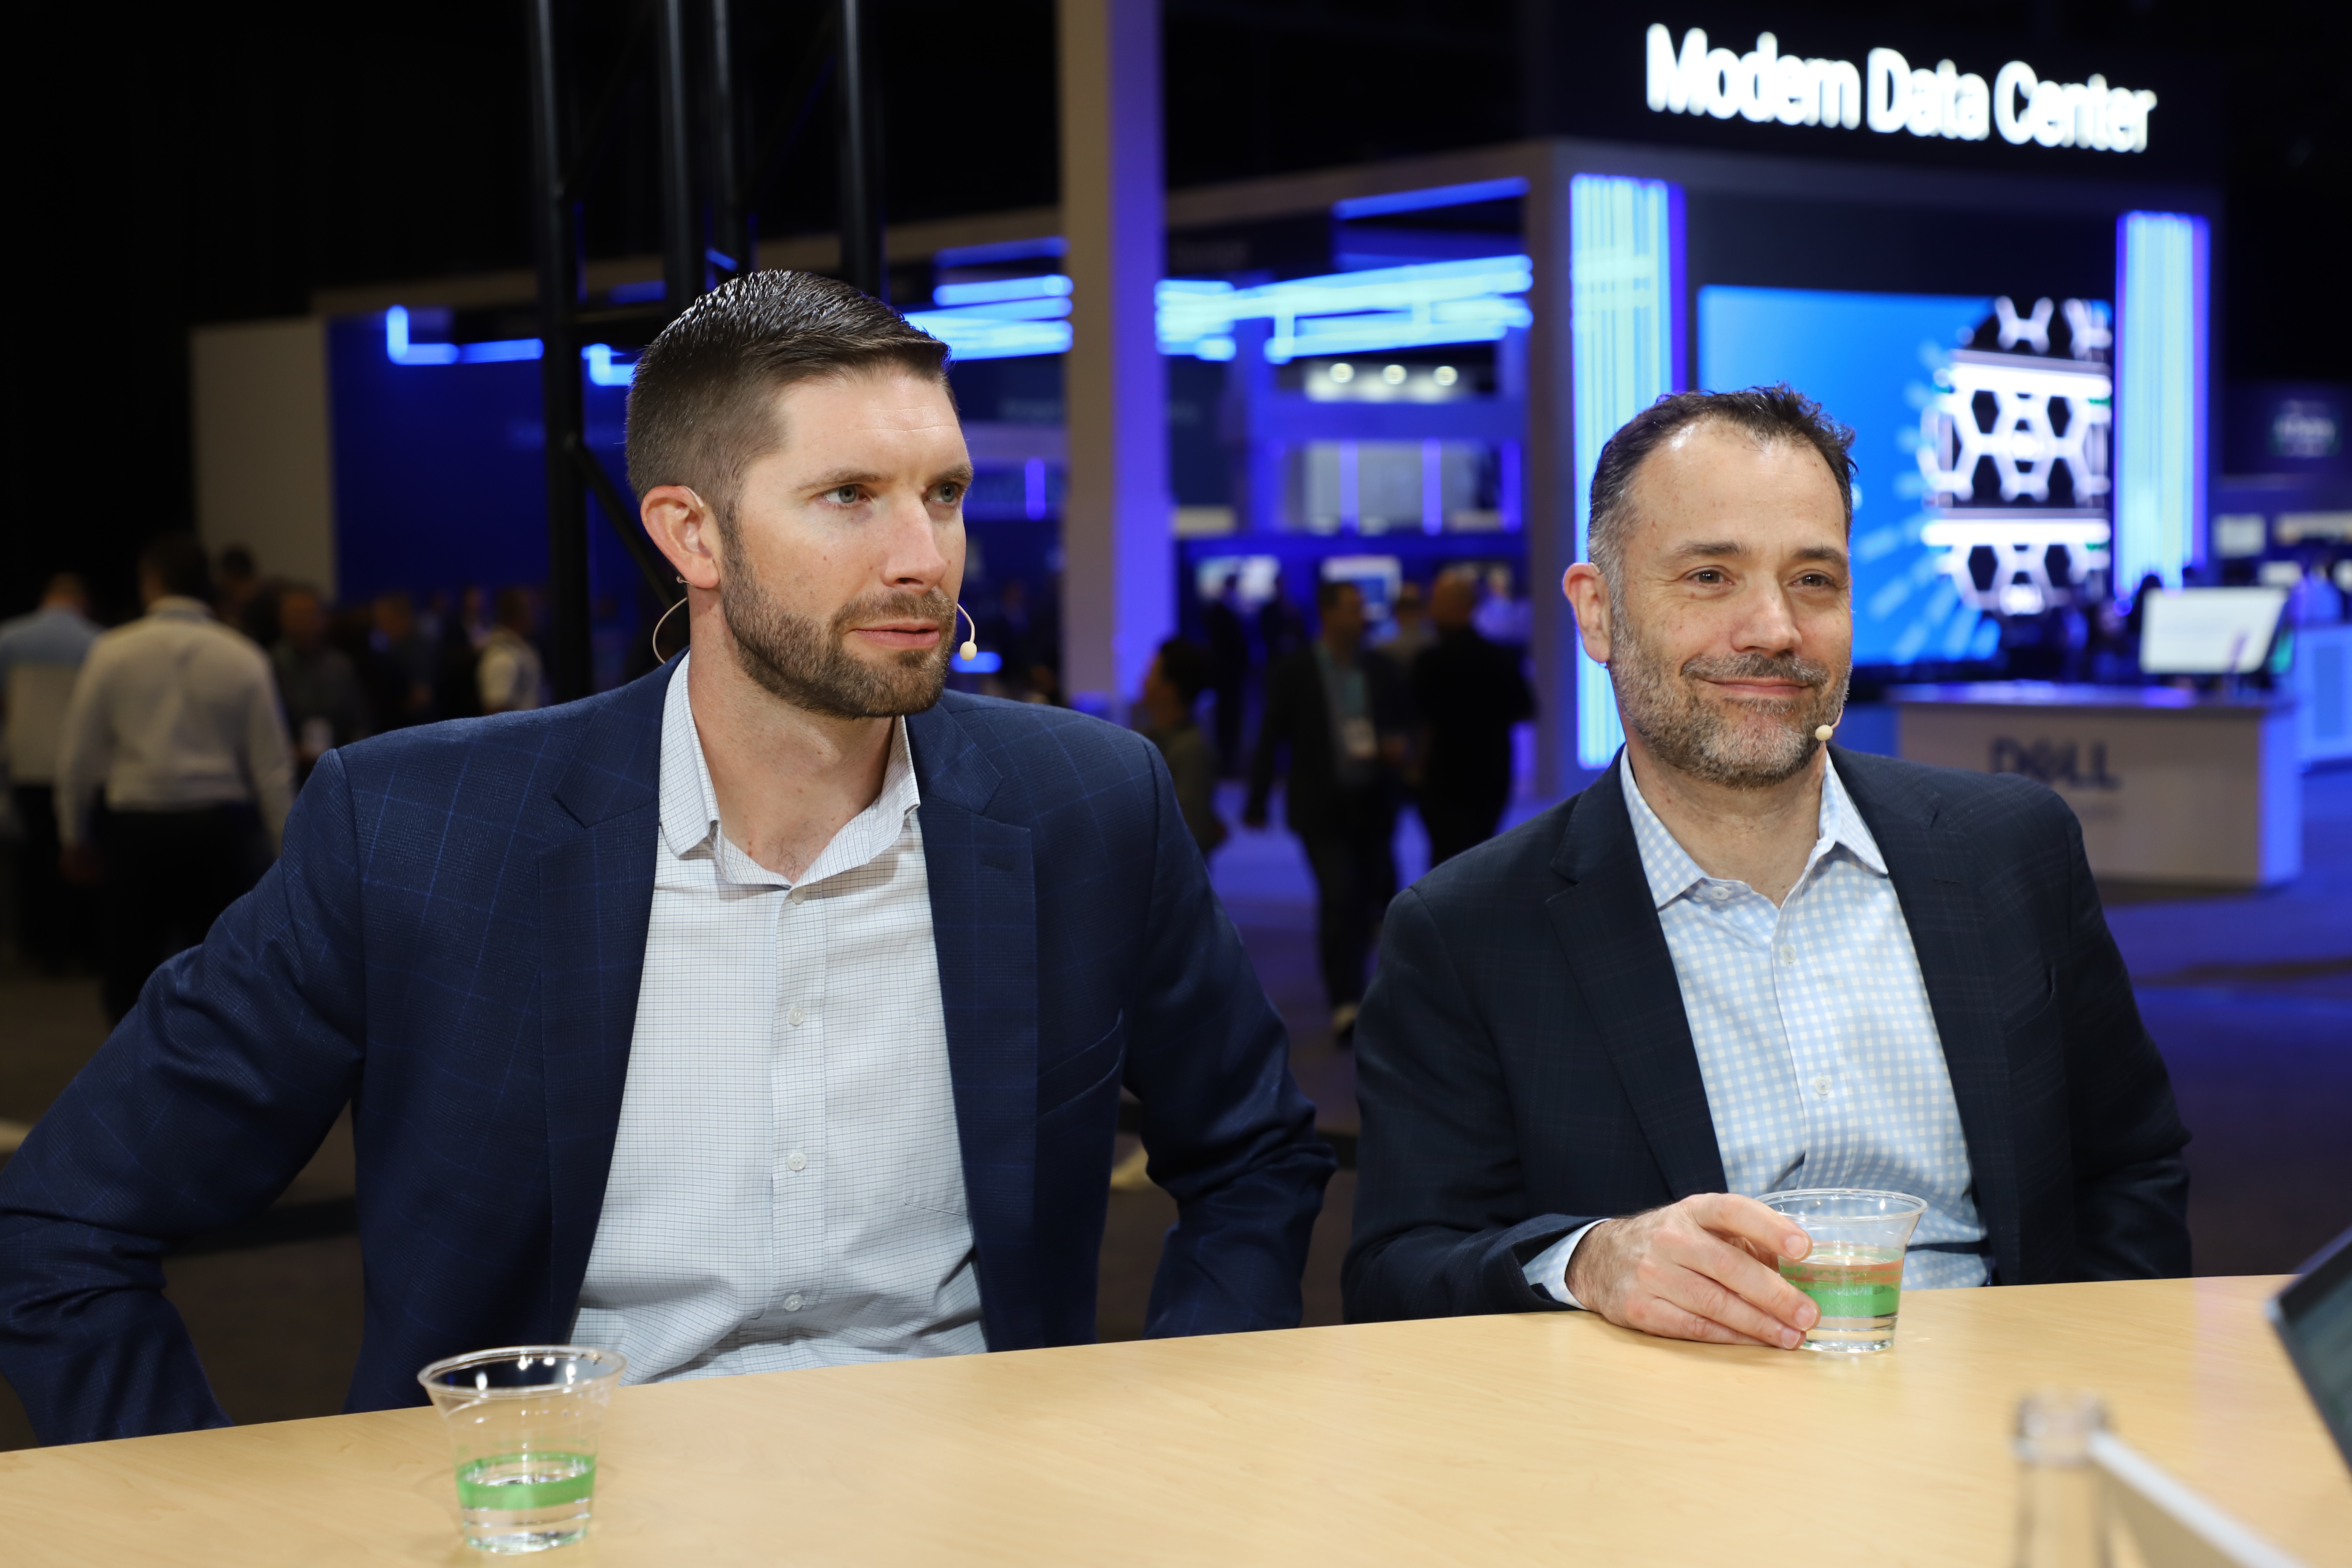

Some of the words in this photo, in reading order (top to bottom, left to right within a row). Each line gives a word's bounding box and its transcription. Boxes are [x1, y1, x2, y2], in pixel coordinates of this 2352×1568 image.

[1647, 23, 1860, 129] Modern
[1867, 47, 1989, 140] Data
[1994, 61, 2156, 152] Center
[1991, 737, 2121, 790] DELL
